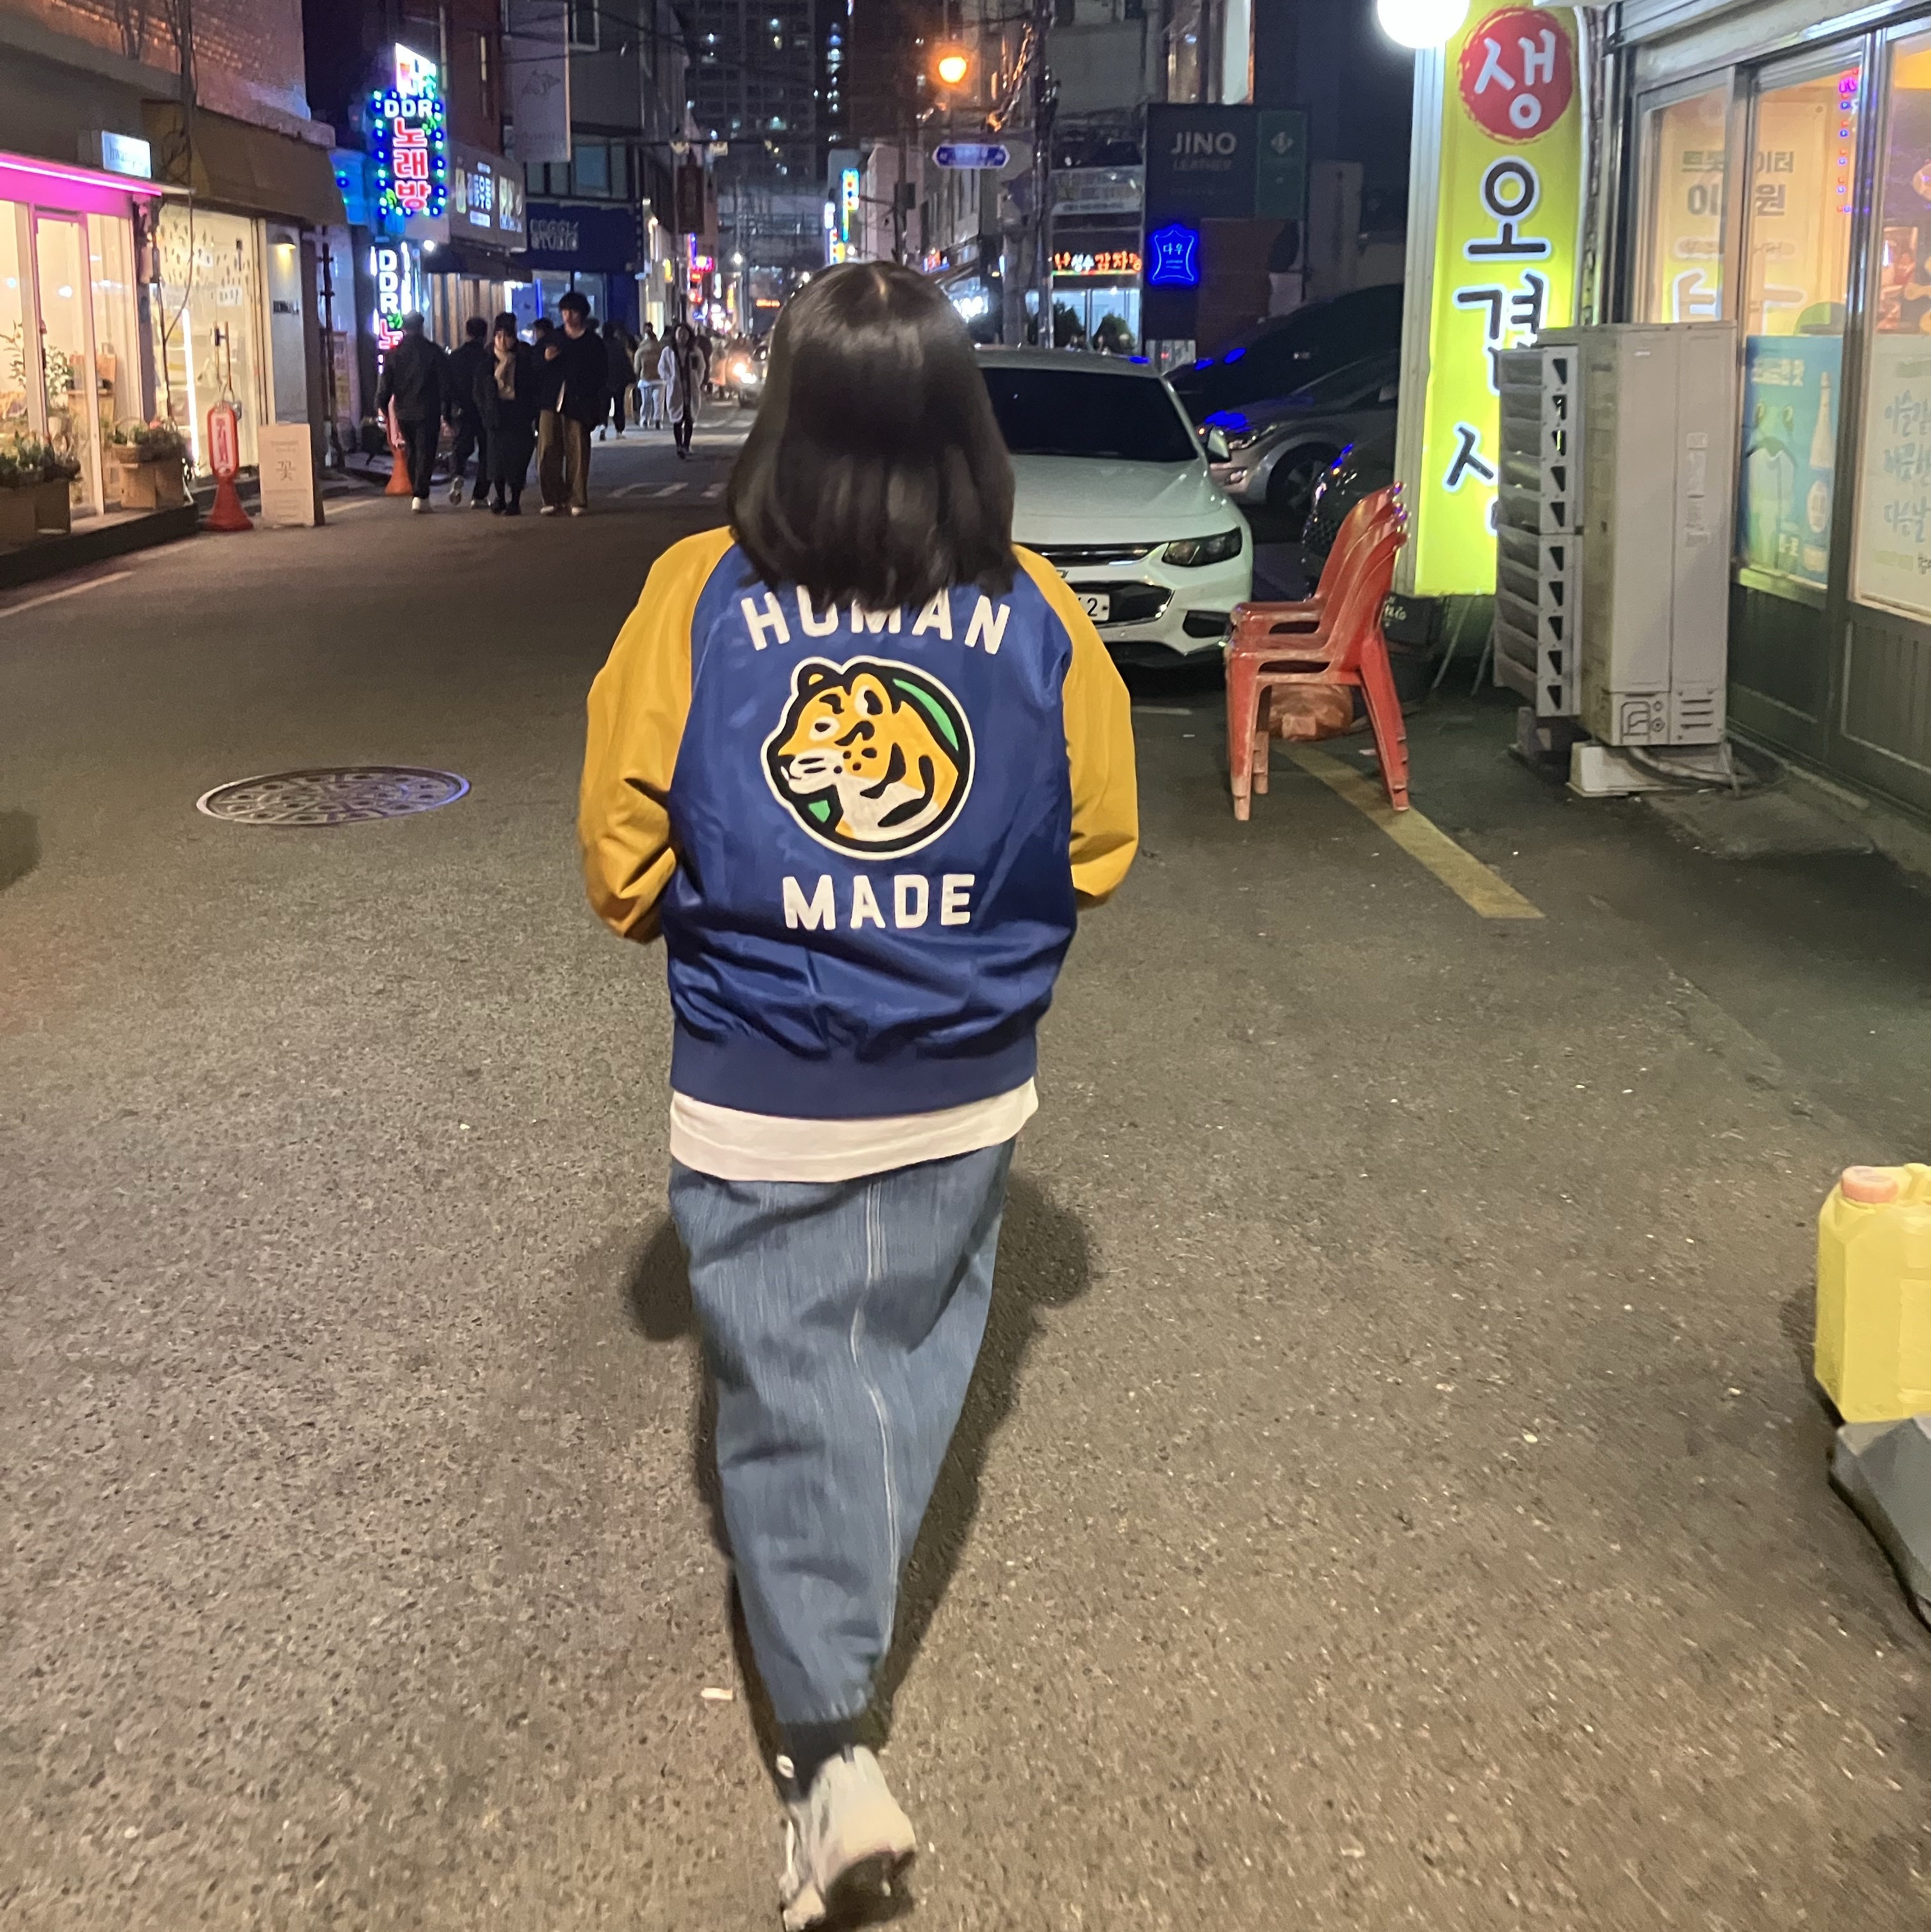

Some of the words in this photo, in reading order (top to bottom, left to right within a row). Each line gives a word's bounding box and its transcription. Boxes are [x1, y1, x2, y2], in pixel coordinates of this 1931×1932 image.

[384, 99, 433, 118] DDR
[393, 117, 432, 211] 노래방
[1171, 132, 1237, 155] JINO
[1686, 183, 1786, 216] 이원
[379, 249, 399, 314] DDR
[1444, 28, 1556, 535] 생오겹
[741, 584, 1011, 655] HUMAN
[782, 874, 975, 931] MADE
